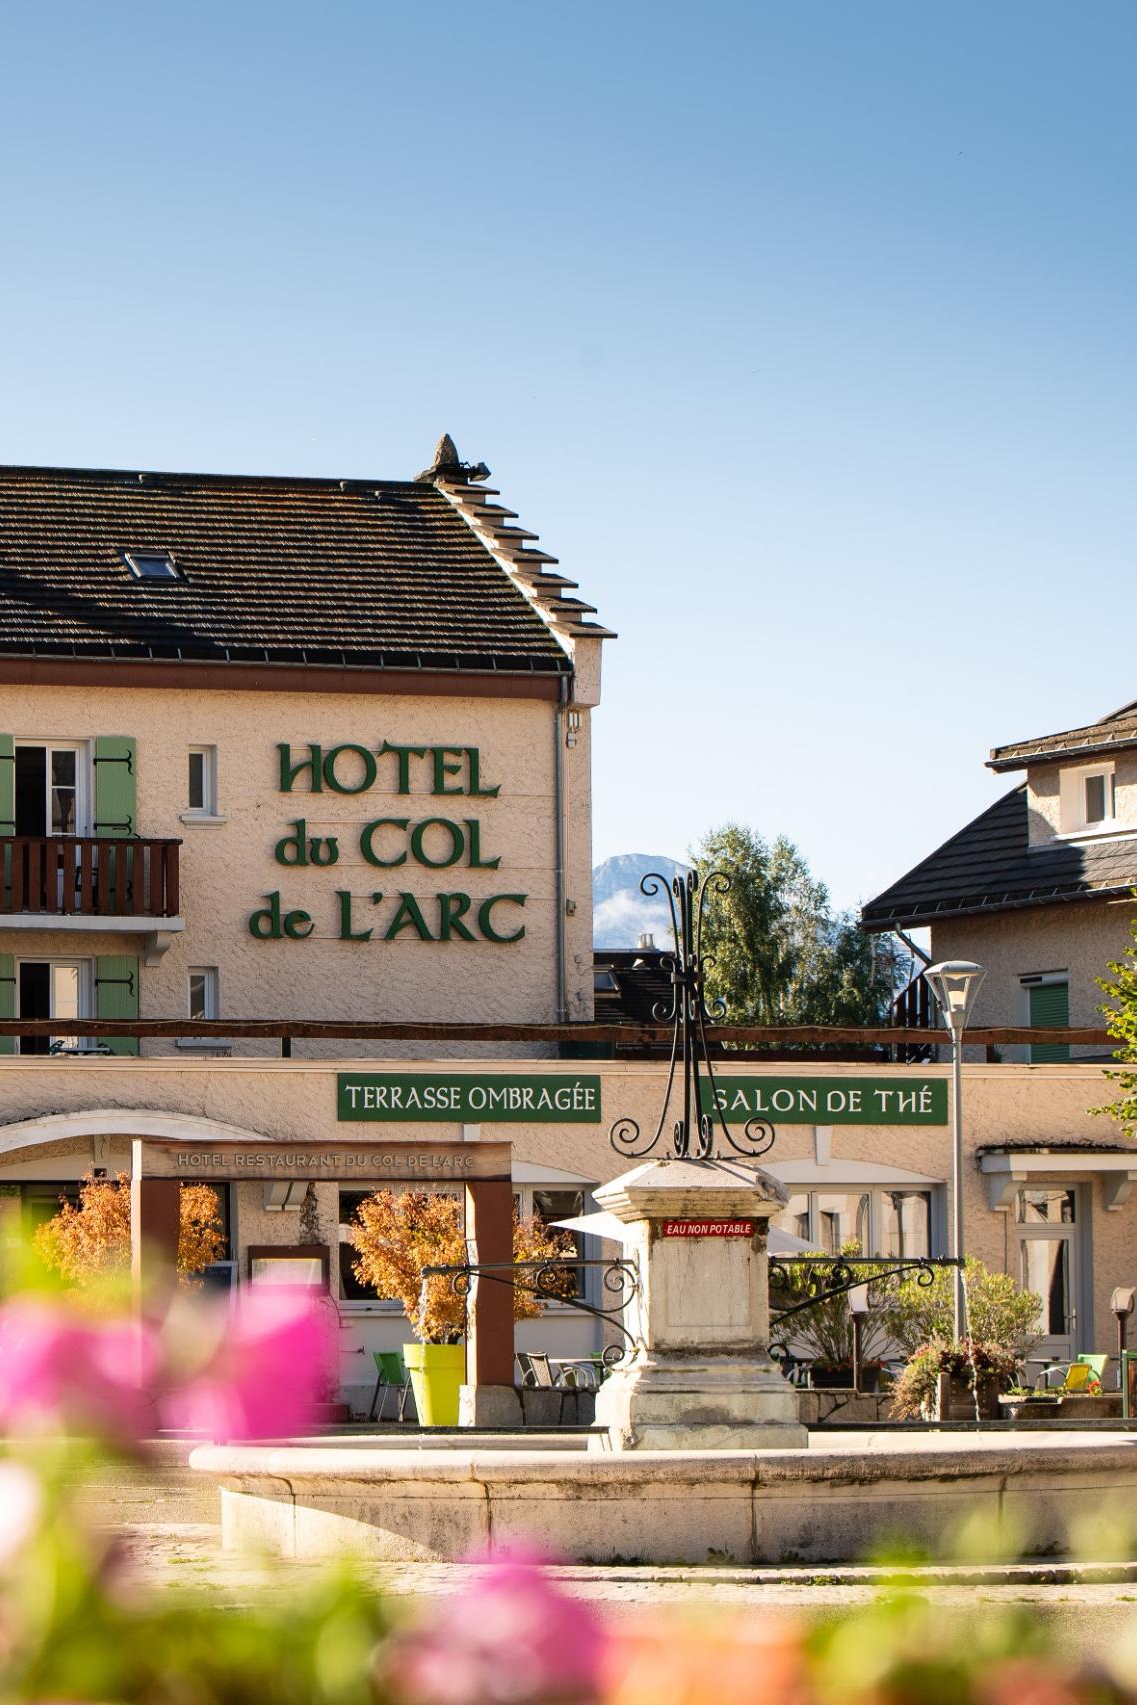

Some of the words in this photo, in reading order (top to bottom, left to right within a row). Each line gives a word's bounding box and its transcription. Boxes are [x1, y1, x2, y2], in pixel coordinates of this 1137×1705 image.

[276, 739, 502, 798] HOTEL
[275, 818, 339, 866] du
[360, 818, 501, 870] COL
[249, 891, 315, 939] de
[336, 890, 528, 943] L'ARC
[345, 1084, 461, 1109] TERRASSE
[468, 1082, 596, 1111] OMBRAGÉE
[713, 1089, 817, 1112] SALON
[826, 1090, 862, 1112] DE
[873, 1085, 932, 1113] THÉ
[235, 1154, 341, 1168] RESTAURANT
[345, 1154, 367, 1168] DU
[373, 1154, 400, 1168] COL
[408, 1154, 428, 1168] DE
[667, 1225, 686, 1234] EAU
[687, 1225, 708, 1234] NON
[709, 1224, 751, 1234] POTABLE
